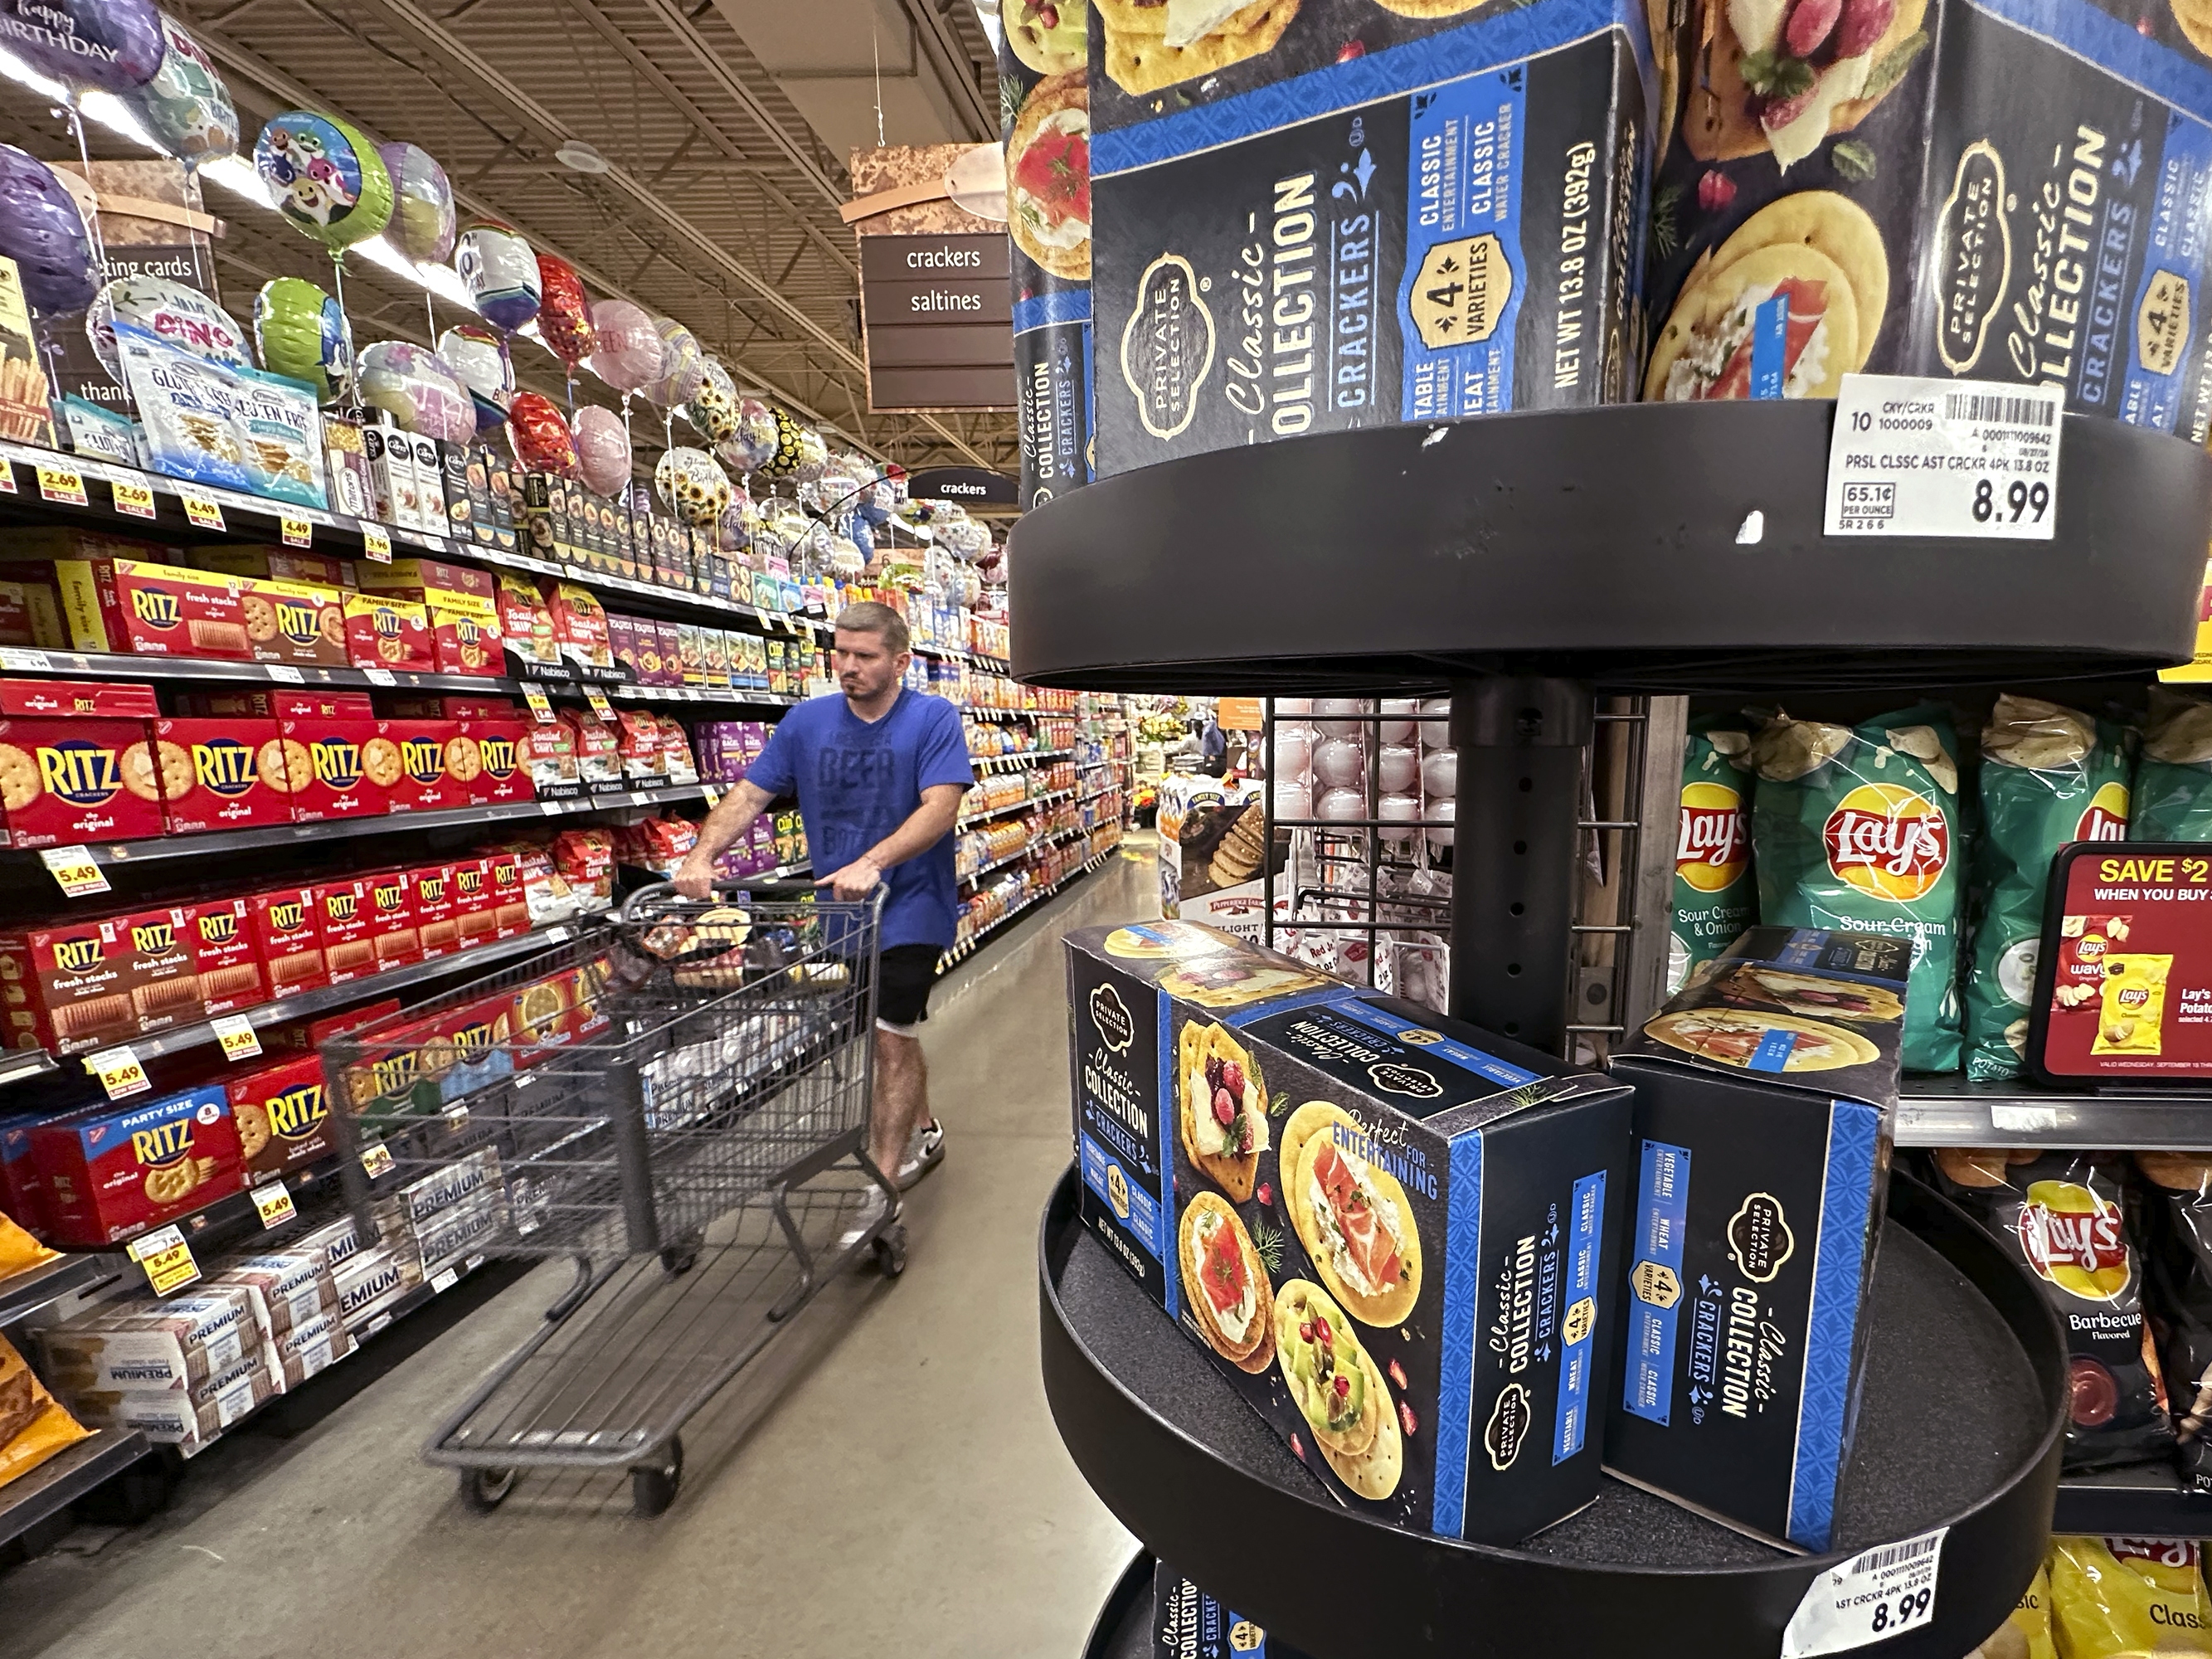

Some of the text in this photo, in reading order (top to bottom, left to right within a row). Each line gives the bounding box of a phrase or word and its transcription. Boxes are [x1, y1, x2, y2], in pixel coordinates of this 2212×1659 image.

[1442, 119, 1458, 231] ENTERTAINMENT
[1471, 121, 1495, 214] CLASSIC
[1495, 103, 1511, 222] WATER CRACKER
[1420, 135, 1441, 226] CLASSIC
[2156, 158, 2179, 247] CLASSIC
[100, 256, 192, 280] eting cards
[907, 245, 981, 269] crackers
[1554, 141, 1595, 389] NET WT 13.8 OZ (392g)
[1950, 181, 1981, 335] PRIVATE
[1962, 178, 1992, 344] SELECTION
[1427, 282, 1464, 308] 4
[1467, 241, 1487, 336] VARIETIES
[2008, 181, 2061, 379] Classic
[911, 289, 981, 313] saltines
[1337, 212, 1369, 407] CRACKERS
[2082, 200, 2133, 403] CRACKERS
[1170, 279, 1181, 412] SELECTION
[1224, 240, 1266, 416] Classic
[1155, 289, 1167, 410] PRIVATE
[1023, 387, 1037, 459] Classic
[1034, 362, 1054, 479] COLLECTION
[1059, 380, 1073, 455] CRACKERS
[1851, 401, 1934, 431] 10 CKY/CRKR
[1879, 418, 1932, 430] 1000009
[45, 472, 76, 488] 2.69
[1845, 455, 2049, 473] PRSL CLSSC AST CRCKR 4PK 13.8 OZ
[118, 487, 148, 502] 2.69
[941, 482, 987, 496] crackers
[1847, 487, 1892, 502] 65.1¢
[1971, 479, 2049, 523] 8.99
[190, 502, 216, 515] 4.49
[1844, 506, 1891, 514] PER OUNCE
[285, 521, 309, 533] 4.49
[368, 537, 387, 551] 3.96
[131, 588, 182, 623] RITZ
[186, 591, 237, 606] fresh stacks
[362, 597, 407, 610] FAMILY SIZE
[277, 603, 321, 637] RITZ
[373, 611, 403, 635] RITZ
[457, 622, 481, 642] RITZ
[541, 666, 570, 678] Nabisco
[600, 668, 625, 679] Nabisco
[36, 747, 123, 795] RITZ
[192, 744, 259, 786] RITZ
[311, 742, 364, 780] RITZ
[401, 742, 445, 773] RITZ
[479, 740, 518, 771] RITZ
[551, 786, 578, 797] Nabisco
[642, 778, 664, 788] Nabisco
[73, 816, 114, 831] original
[1836, 813, 1942, 878] Lay's
[59, 865, 96, 882] 5.49
[457, 869, 483, 890] RITZ
[495, 865, 517, 885] RITZ
[2099, 858, 2208, 883] SAVE $2
[327, 896, 357, 917] RITZ
[374, 887, 402, 907] RITZ
[420, 879, 445, 900] RITZ
[2094, 888, 2208, 901] WHEN YOU BUY
[198, 914, 239, 940] RITZ
[270, 902, 305, 929] RITZ
[1694, 920, 1741, 936] & Onion
[53, 936, 105, 969] RITZ
[131, 922, 177, 952] RITZ
[1310, 946, 1326, 959] Red
[2182, 988, 2210, 1001] Lay's
[1095, 1010, 1129, 1037] SELECTION
[1096, 1000, 1125, 1025] PRIVATE
[225, 1033, 252, 1048] 5.49
[1290, 1020, 1380, 1063] COLLECTION
[105, 1066, 139, 1086] 5.49
[1095, 1047, 1134, 1092] Classic
[123, 1099, 194, 1128] PARTY SIZE
[265, 1084, 328, 1137] RITZ
[1085, 1066, 1149, 1139] COLLECTION
[131, 1118, 195, 1165] RITZ
[1096, 1111, 1138, 1161] CRACKERS
[1348, 1107, 1408, 1148] Perfect
[1332, 1121, 1438, 1201] ENTERTAINING
[1407, 1144, 1427, 1167] FOR
[1662, 1152, 1675, 1198] VEGETABLE
[262, 1197, 289, 1216] 5.49
[1580, 1192, 1591, 1232] CLASSIC
[1659, 1218, 1670, 1250] WHEAT
[1748, 1204, 1762, 1269] SELECTION
[1759, 1208, 1772, 1269] PRIVATE
[2027, 1206, 2118, 1272] Lay's
[273, 1265, 324, 1298] PREMIUM
[1577, 1249, 1586, 1288] CLASSIC
[1642, 1264, 1654, 1301] VARIETIES
[1489, 1269, 1512, 1353] Classic
[1510, 1234, 1537, 1374] COLLECTION
[1538, 1249, 1557, 1339] CRACKERS
[190, 1305, 246, 1344] PREMIUM
[286, 1316, 336, 1353] PREMIUM
[1581, 1299, 1590, 1337] VARIETIES
[2069, 1312, 2142, 1330] Barbecue
[2092, 1331, 2130, 1340] Flavored
[1650, 1318, 1662, 1355] CLASSIC
[1692, 1297, 1716, 1386] CRACKERS
[1721, 1287, 1759, 1418] COLLECTION
[1568, 1360, 1578, 1391] WHEAT
[1754, 1317, 1787, 1401] Classic
[200, 1357, 257, 1399] PREMIUM
[1646, 1370, 1658, 1407] CLASSIC
[1500, 1401, 1510, 1457] PRIVATE
[1507, 1394, 1517, 1456] SELECTION
[1563, 1408, 1573, 1454] VEGETABLE
[1854, 1590, 1883, 1606] CRCKR
[1885, 1584, 1902, 1597] 4PK
[1904, 1579, 1918, 1590] 13.8
[1920, 1573, 1932, 1584] OZ
[1162, 1592, 1179, 1646] Classic
[1872, 1588, 1931, 1632] 8.99
